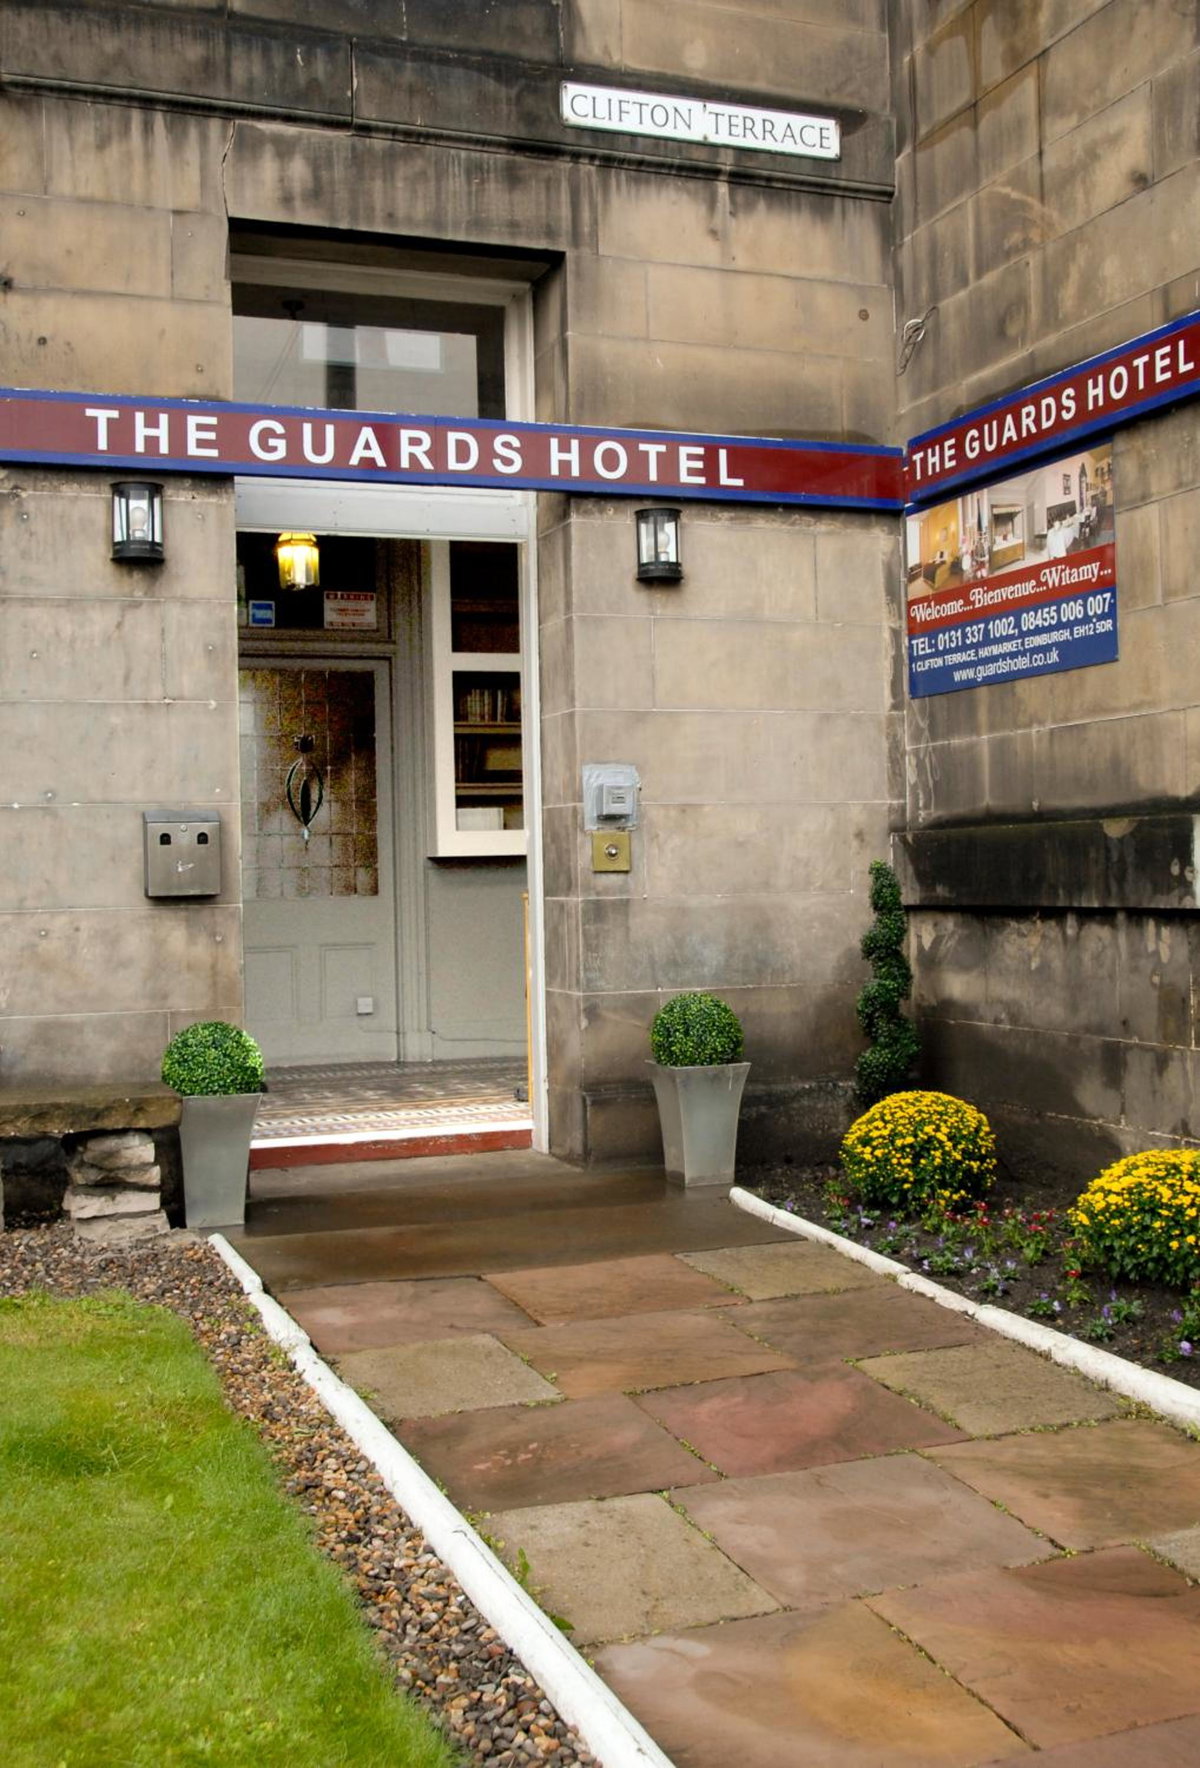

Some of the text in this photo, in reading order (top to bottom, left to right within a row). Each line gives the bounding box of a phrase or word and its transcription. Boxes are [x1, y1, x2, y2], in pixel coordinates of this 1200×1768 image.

[570, 94, 831, 149] CLIFTON TERRACE
[912, 340, 1194, 480] THE GUARDS HOTEL
[85, 408, 744, 486] THE GUARDS HOTEL
[911, 593, 1112, 656] TEL: 0131 337 1002, 08455 006 007
[916, 657, 943, 672] CLIFTON
[944, 649, 977, 666] TERRACE,
[978, 639, 1023, 658] HAYMARKET,
[1025, 628, 1072, 649] EDINBURGH,
[1073, 623, 1094, 639] EH12
[1096, 620, 1113, 634] 5DR
[953, 647, 1060, 681] www.guardshotel.co.uk
